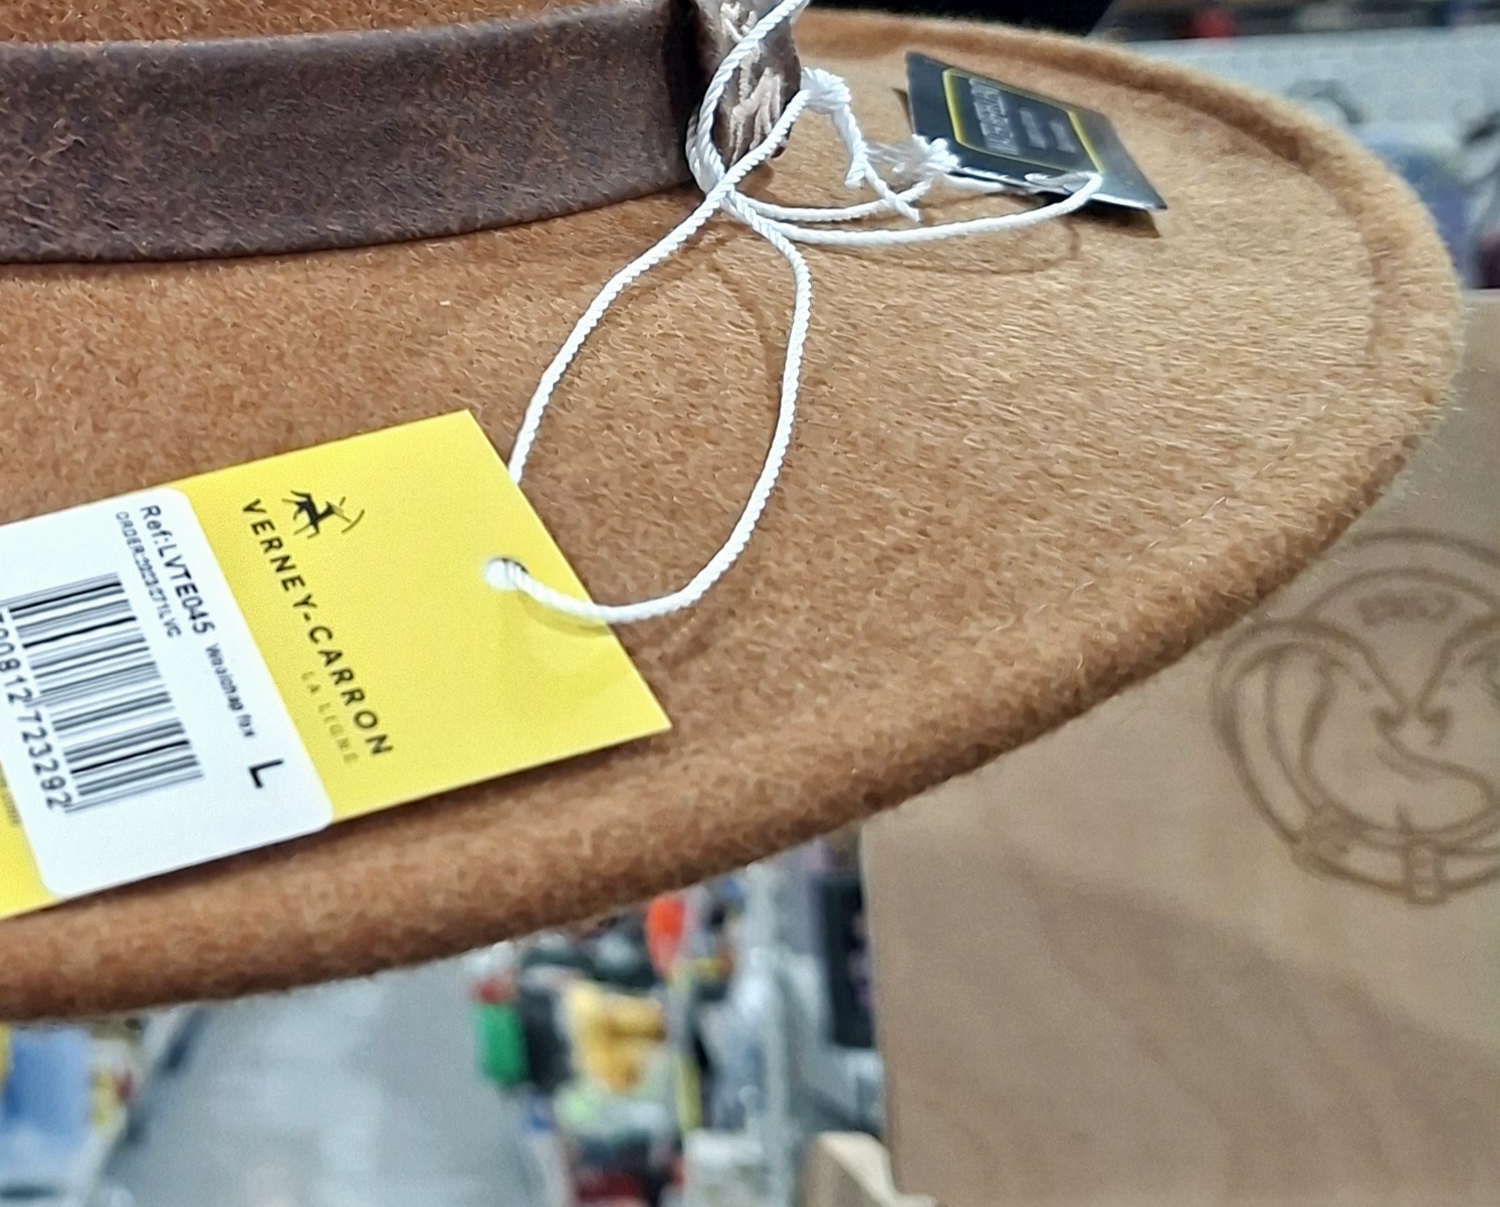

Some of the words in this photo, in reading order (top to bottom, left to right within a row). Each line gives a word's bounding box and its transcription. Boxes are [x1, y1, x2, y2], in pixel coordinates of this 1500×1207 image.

[140, 505, 215, 634] Ref:LVTE045
[249, 759, 283, 788] L
[242, 498, 394, 755] VERNEY-CARRON
[301, 671, 321, 694] LA
[17, 711, 72, 809] 723292
